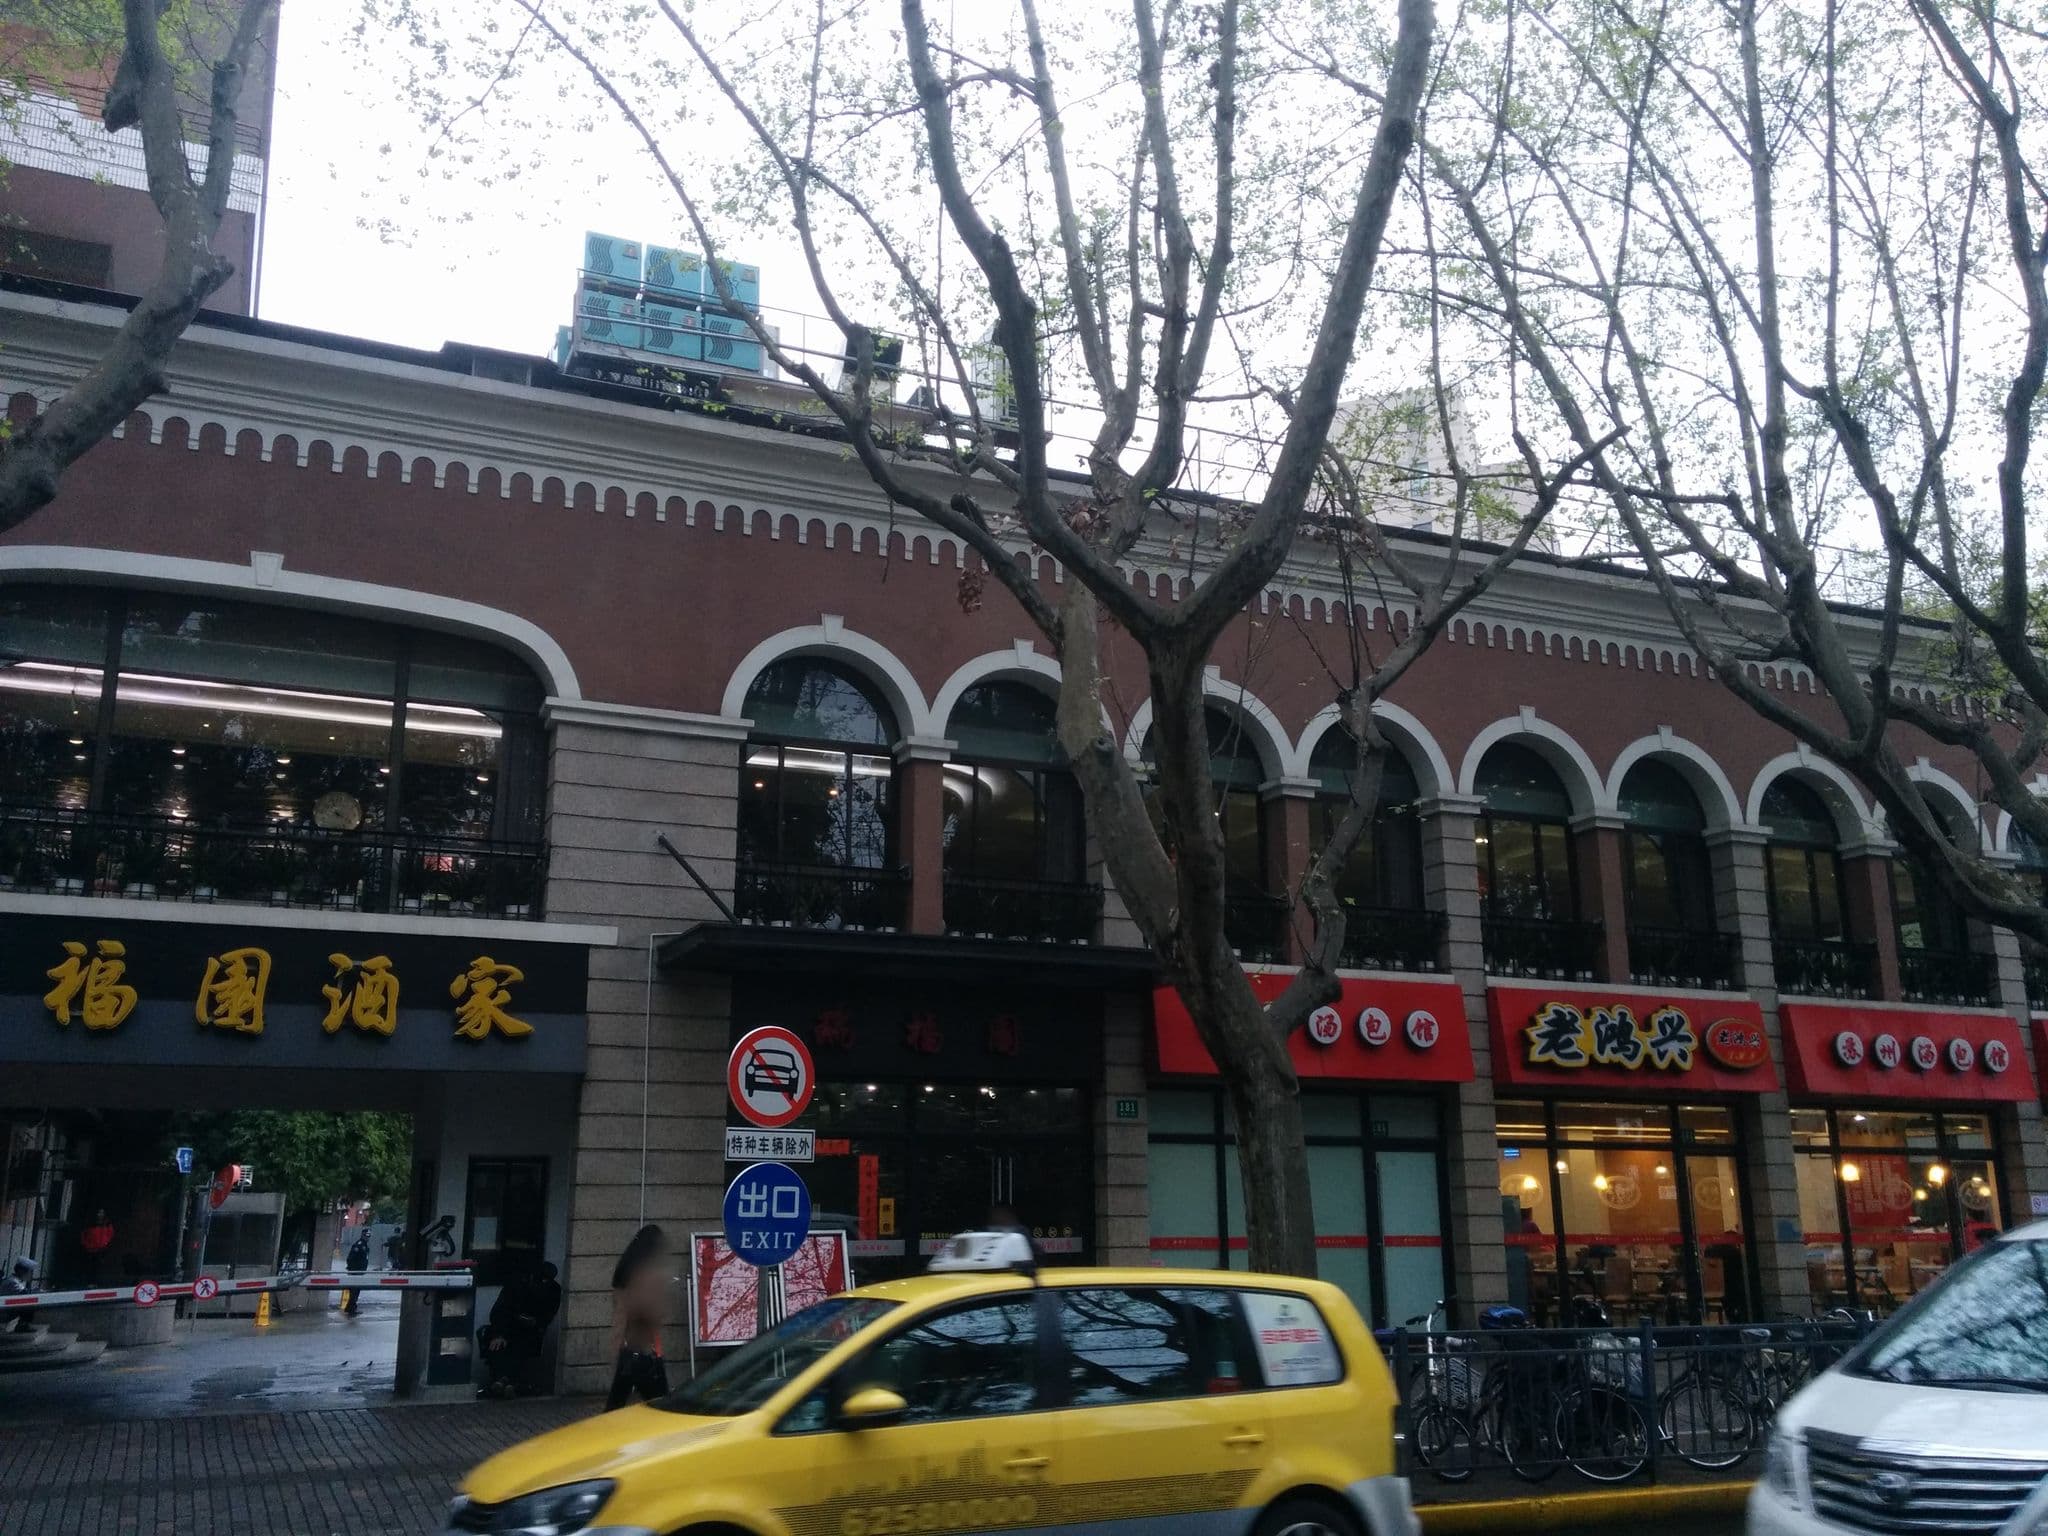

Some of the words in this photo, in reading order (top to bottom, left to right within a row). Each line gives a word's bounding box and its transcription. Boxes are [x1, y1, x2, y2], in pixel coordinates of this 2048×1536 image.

[1315, 1013, 1436, 1043] 汤包馆
[1532, 1004, 1696, 1066] 老鸿兴
[1842, 1036, 2007, 1068] 苏州汤包馆
[1119, 1101, 1136, 1112] 181
[730, 1135, 811, 1156] 特种车辆除外
[738, 1182, 800, 1218] 出口
[740, 1231, 796, 1249] EXIT
